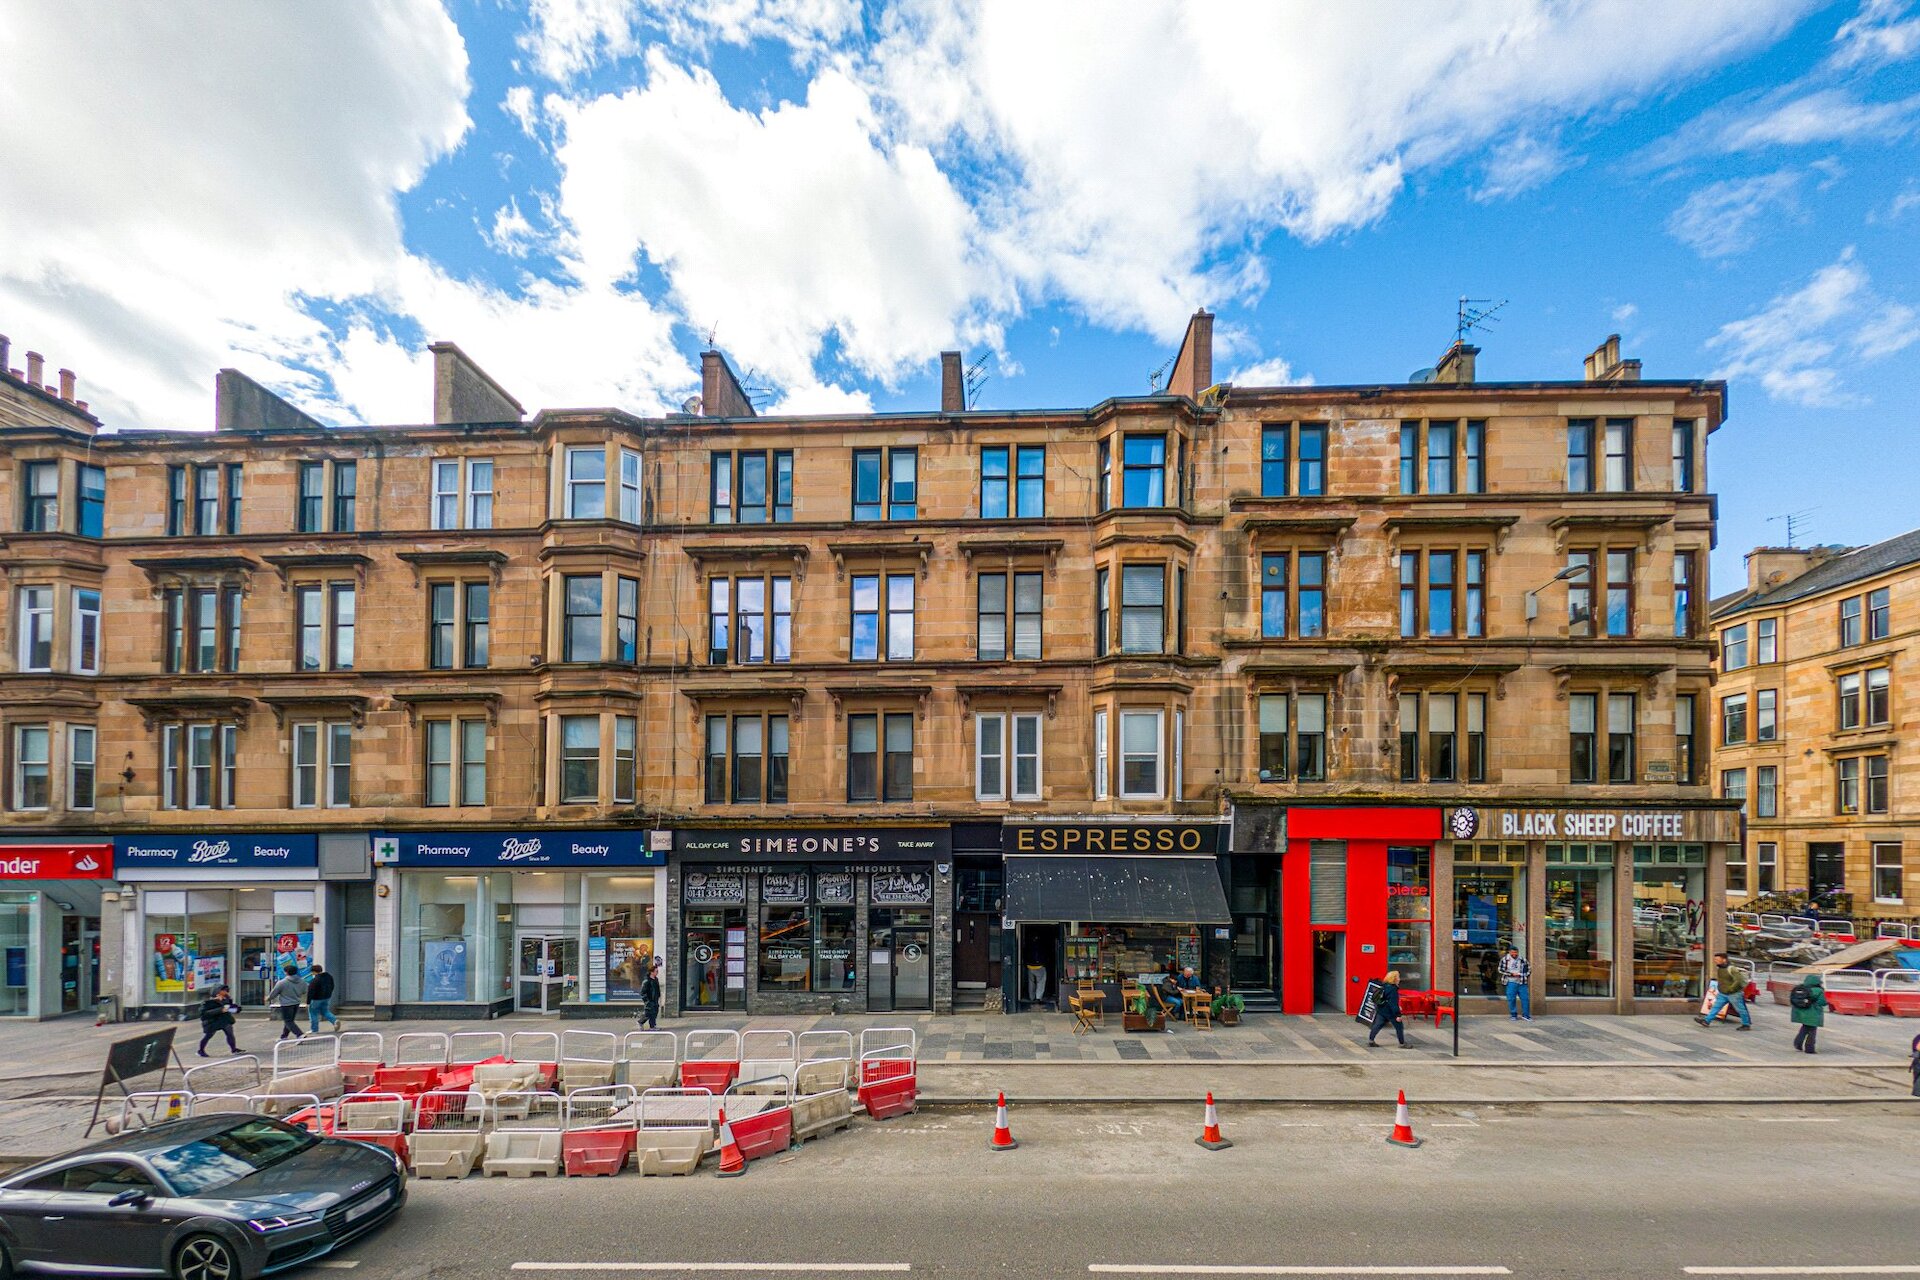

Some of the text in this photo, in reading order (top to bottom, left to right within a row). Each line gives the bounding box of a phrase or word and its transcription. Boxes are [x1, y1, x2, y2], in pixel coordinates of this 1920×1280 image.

[1502, 813, 1683, 837] BLACK SHEEP COFFEE
[740, 836, 880, 853] SIMEONE'S
[1018, 828, 1201, 850] ESPRESSO
[127, 846, 178, 859] Pharmacy
[187, 840, 231, 863] Boots
[253, 846, 290, 859] Beauty
[417, 844, 471, 857] Pharmacy
[498, 837, 542, 862] Boots
[571, 844, 609, 857] Beauty
[0, 856, 40, 874] nder
[716, 865, 773, 873] SIMEONE'S
[844, 865, 901, 873] SIMEONE'S
[766, 875, 788, 886] PASTA
[687, 889, 743, 898] 0141 334 6561
[1386, 883, 1429, 899] piece
[699, 948, 708, 960] S
[908, 948, 916, 959] S
